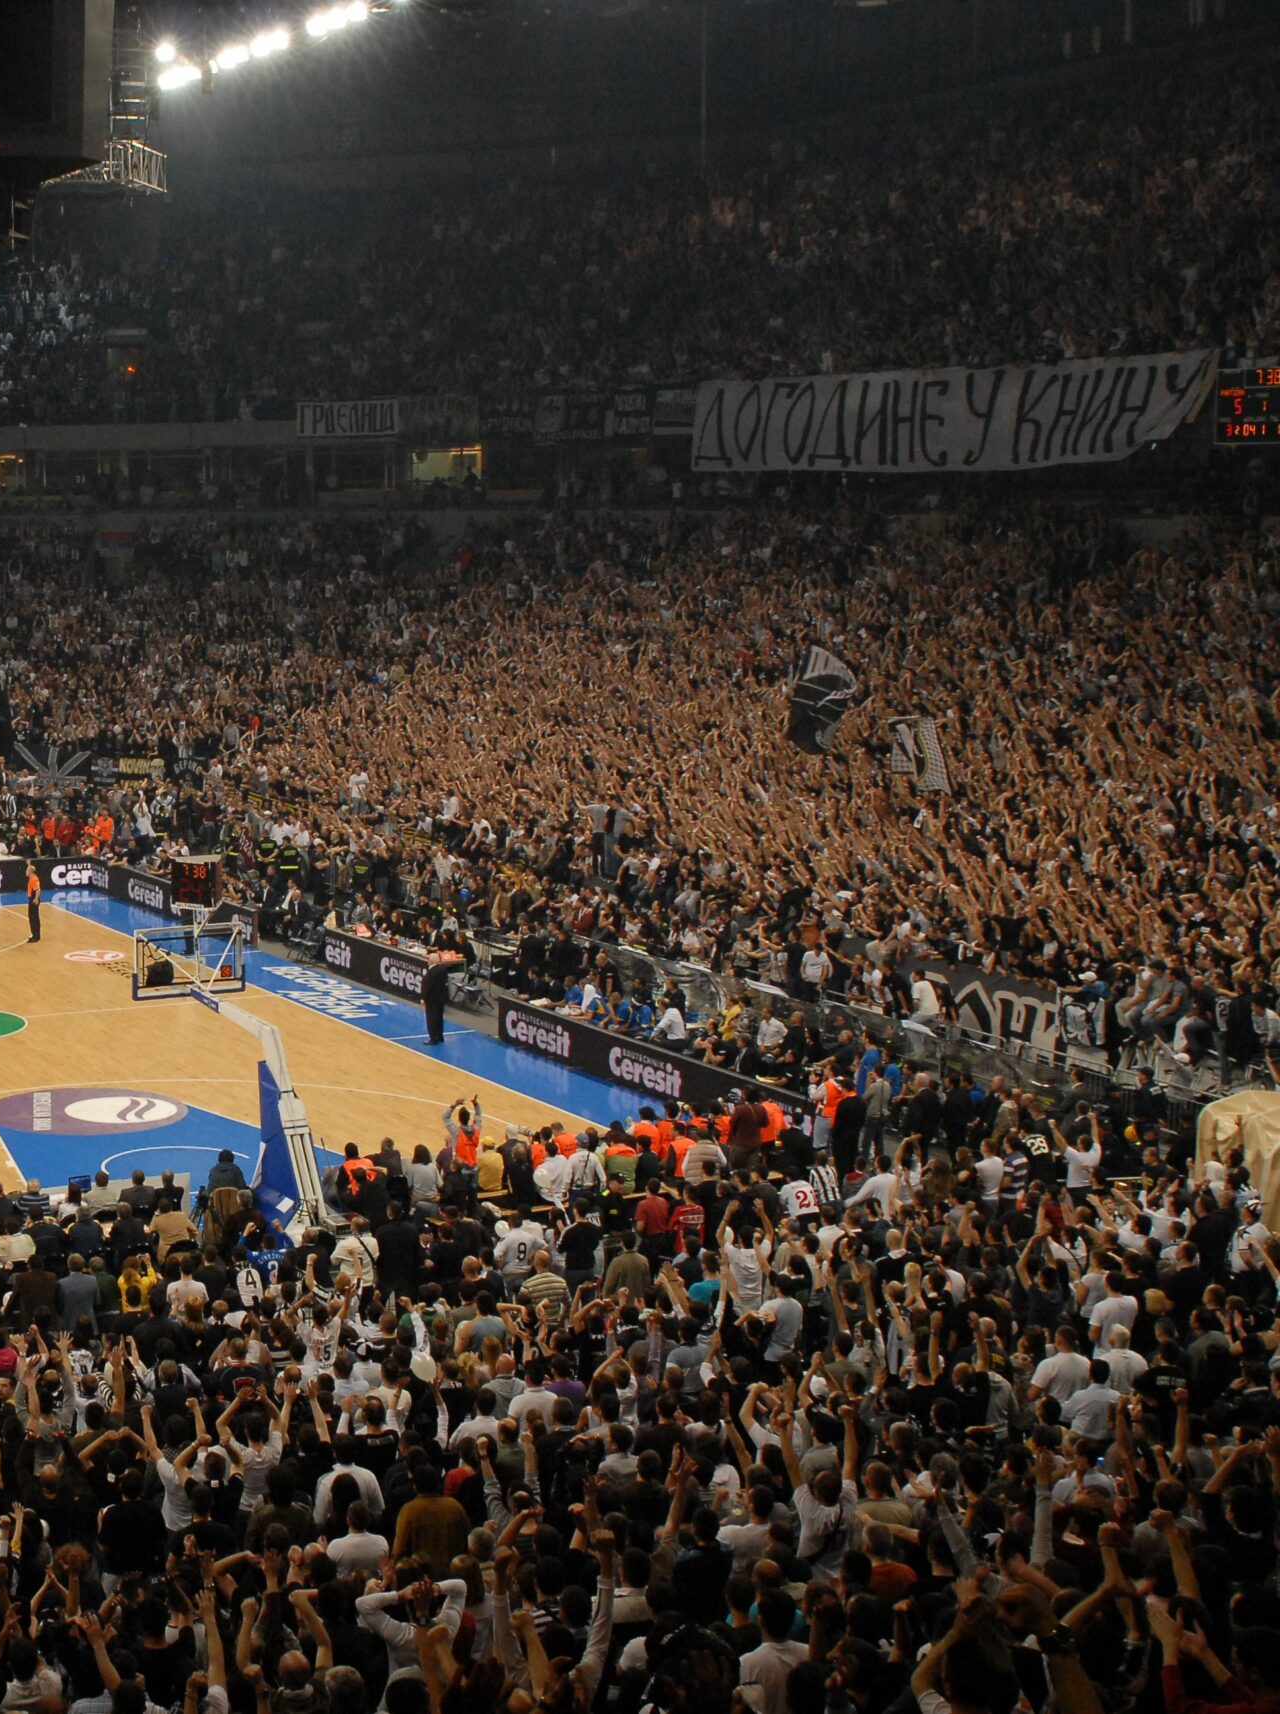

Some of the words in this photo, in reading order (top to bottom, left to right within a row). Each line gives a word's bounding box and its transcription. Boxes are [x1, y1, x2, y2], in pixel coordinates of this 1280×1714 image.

[694, 379, 949, 469] ДОГОДИНЕ
[50, 864, 110, 889] Ceresit
[128, 878, 163, 910] Ceresit
[324, 941, 352, 969] esit
[379, 956, 426, 994] Ceres
[276, 990, 379, 1019] ARENA
[505, 1010, 572, 1058] Ceresit
[516, 1011, 556, 1032] BAUTECHNIK
[608, 1046, 682, 1099] Ceresit
[622, 1048, 665, 1069] BAUTECHNIK
[1026, 1137, 1050, 1156] 29
[516, 1242, 527, 1261] 9
[245, 1269, 257, 1289] 4
